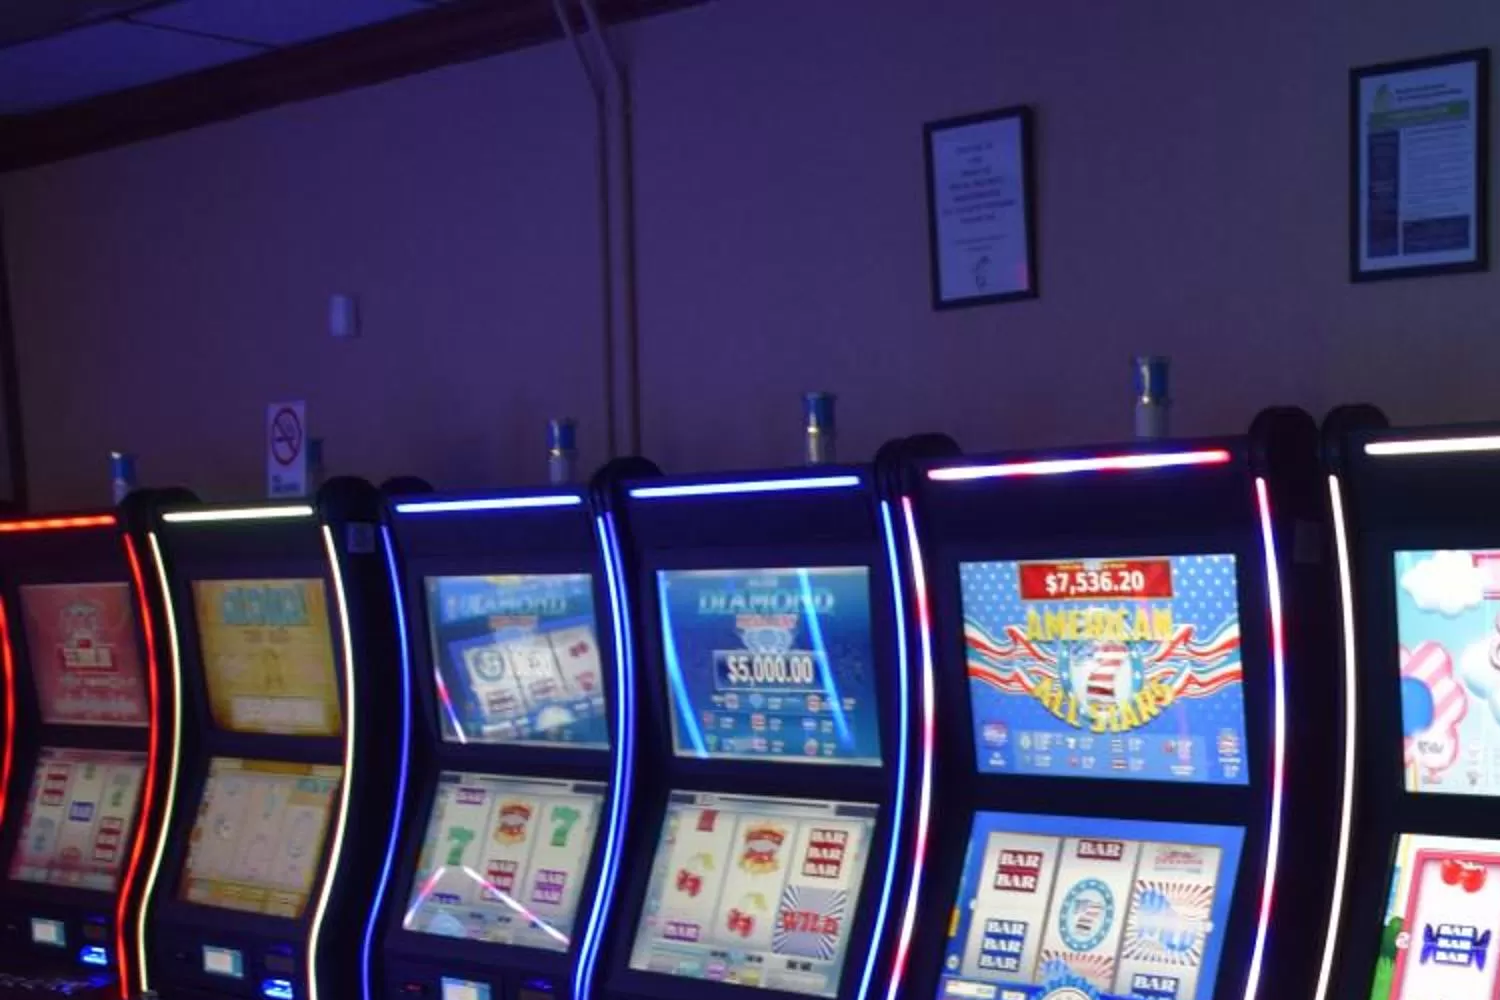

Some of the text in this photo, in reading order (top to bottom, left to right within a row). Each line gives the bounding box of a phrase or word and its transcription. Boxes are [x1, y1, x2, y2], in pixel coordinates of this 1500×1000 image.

[1045, 570, 1145, 596] $7,536.20
[1027, 608, 1174, 640] AMERICAN
[727, 655, 814, 685] $5,000.00
[551, 805, 581, 848] 7
[447, 826, 475, 866] 7
[1079, 841, 1123, 858] BAR
[999, 850, 1040, 869] BAR
[995, 872, 1037, 891] BAR
[987, 920, 1025, 937] BAR
[1439, 925, 1474, 936] BAR
[983, 938, 1022, 954] BAR
[1437, 938, 1472, 950] BAR
[980, 954, 1019, 971] BAR
[1435, 951, 1469, 963] BAR
[1134, 974, 1177, 993] BAR
